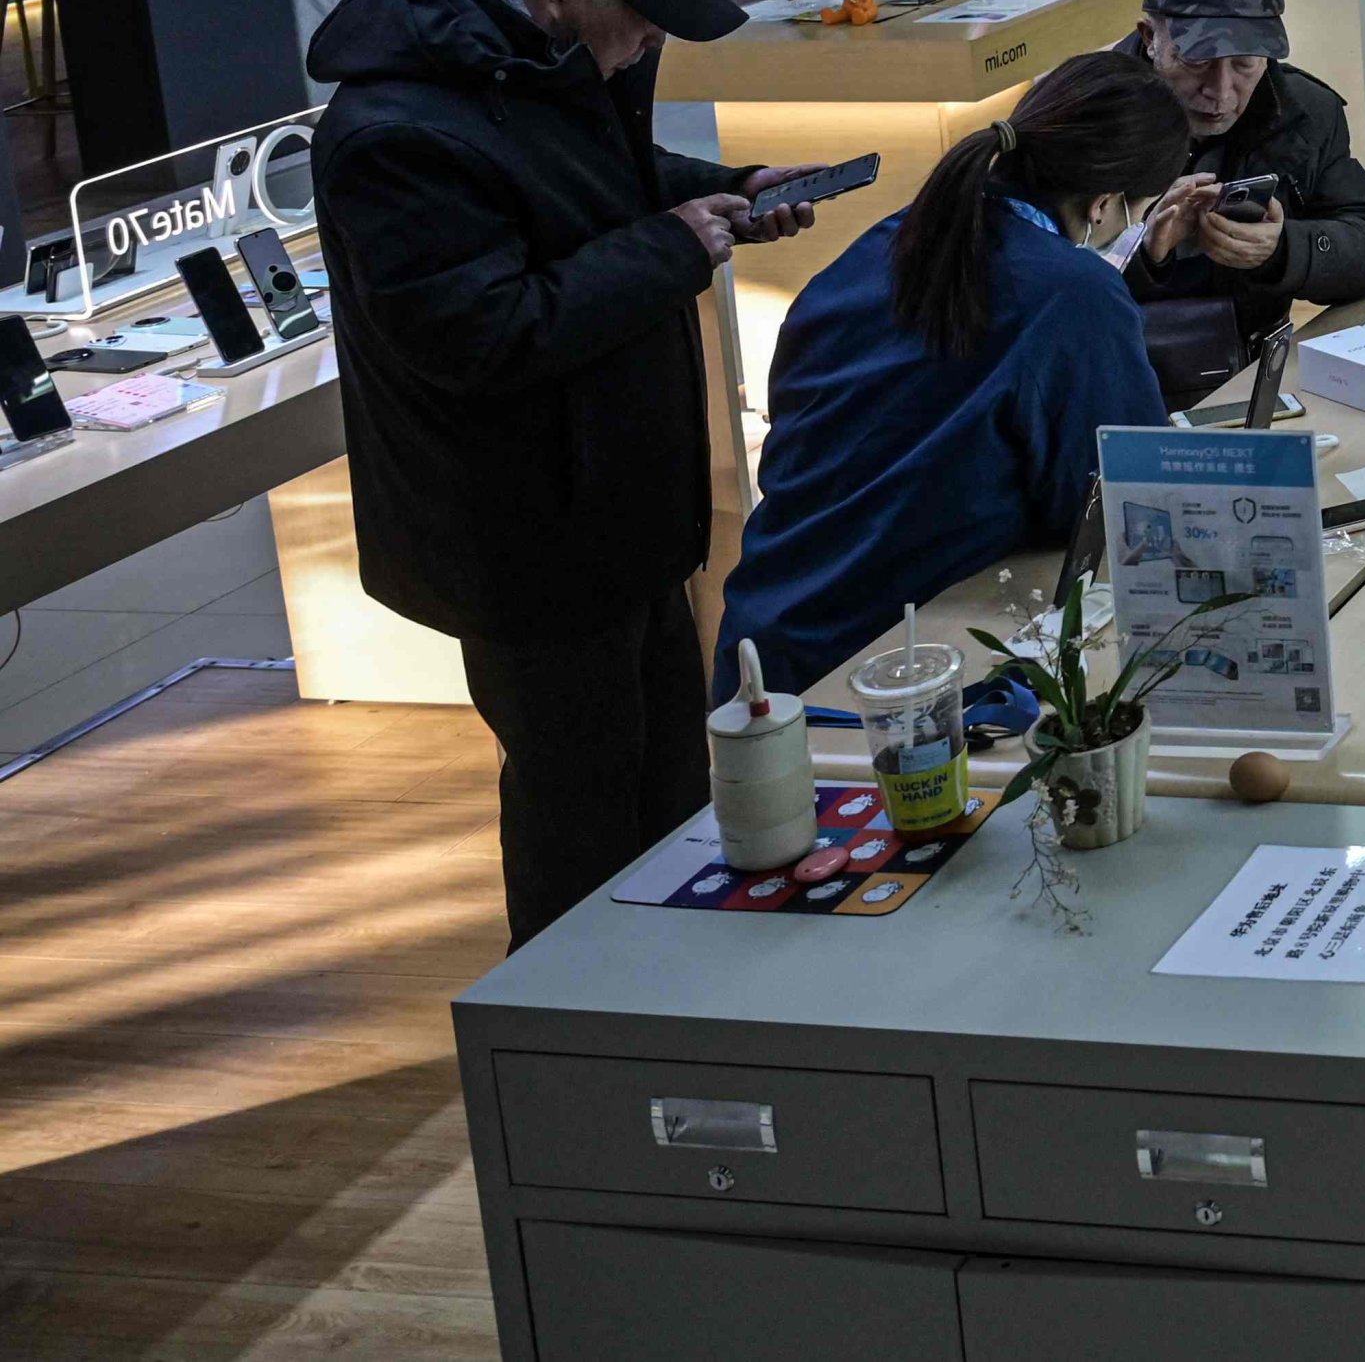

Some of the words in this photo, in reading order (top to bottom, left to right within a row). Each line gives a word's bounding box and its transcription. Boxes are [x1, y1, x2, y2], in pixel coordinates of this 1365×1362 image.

[985, 42, 1027, 73] mi.com
[894, 778, 930, 792] LUCK
[933, 772, 949, 786] IN
[901, 785, 943, 803] HAND
